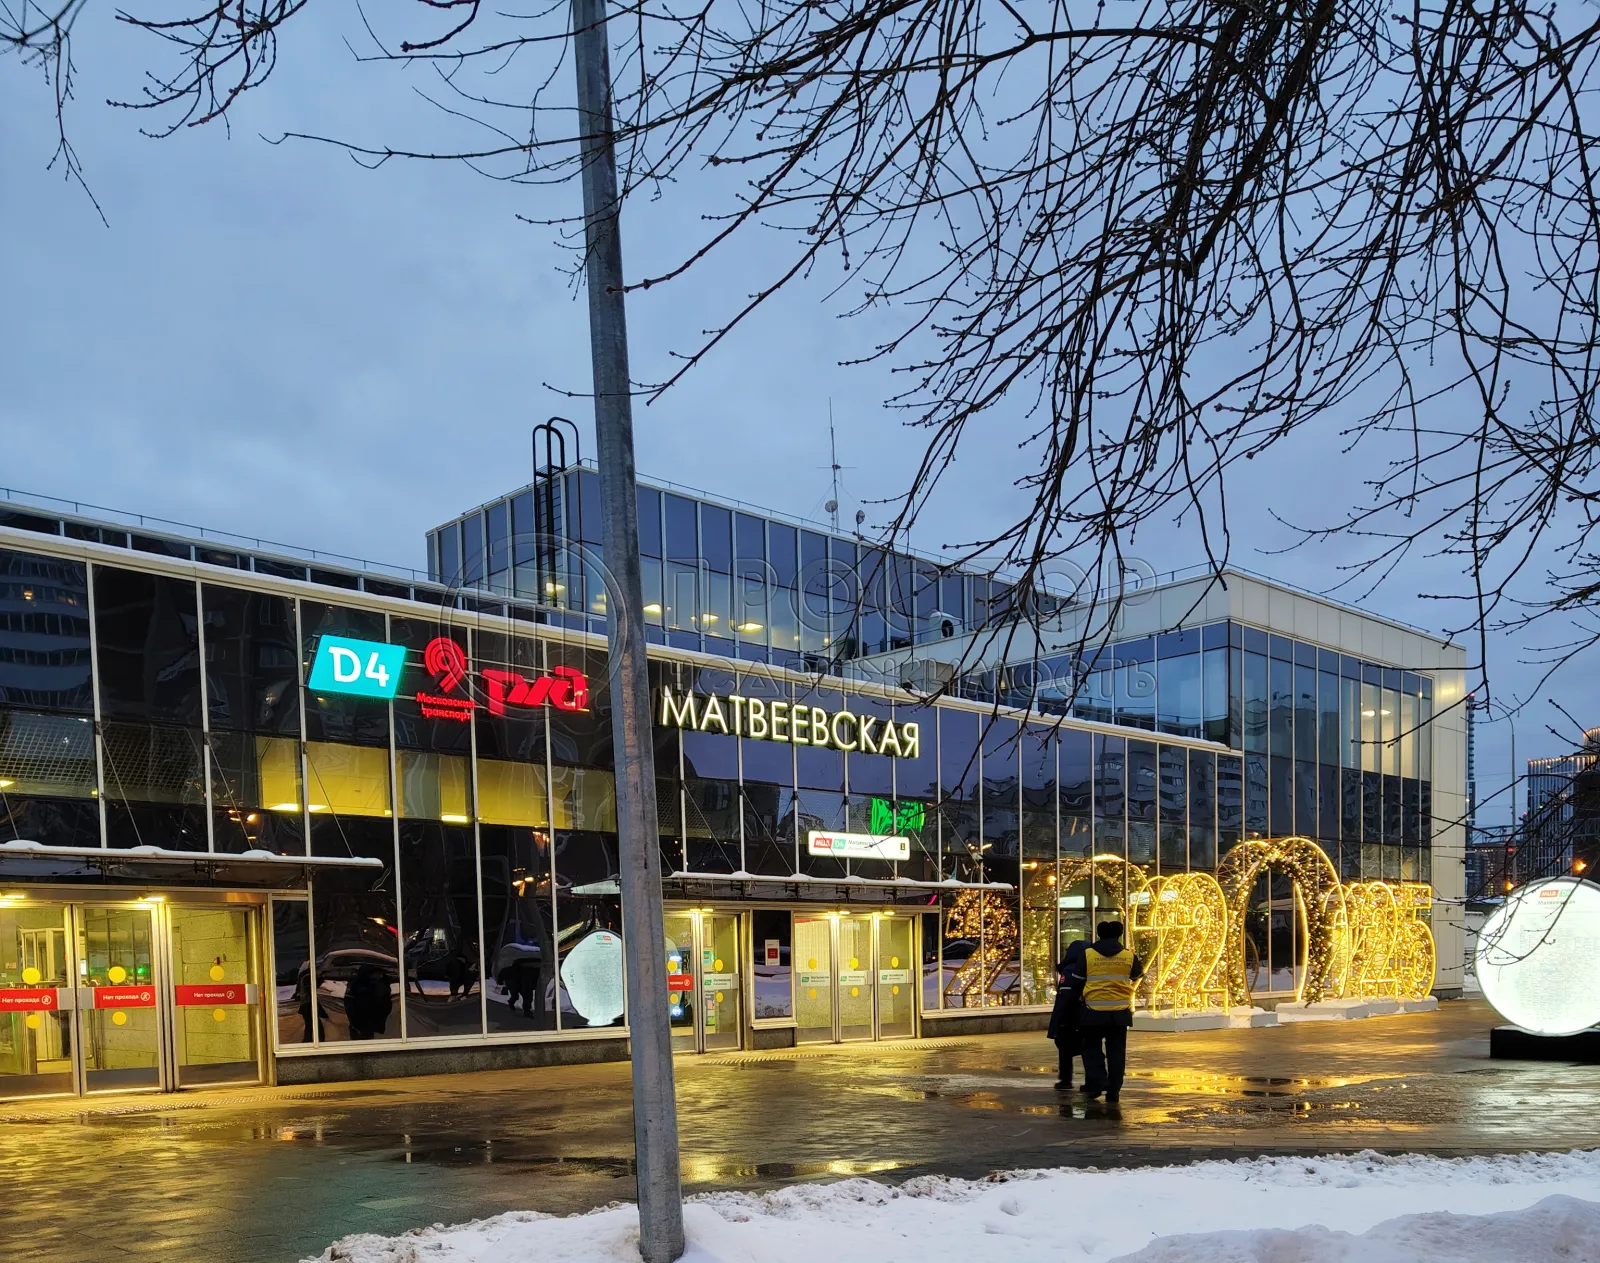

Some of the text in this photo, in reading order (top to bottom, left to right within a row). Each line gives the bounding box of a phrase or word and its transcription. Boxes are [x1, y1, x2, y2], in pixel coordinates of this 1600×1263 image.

[328, 646, 390, 687] D4
[416, 691, 476, 709] Московский
[422, 707, 471, 722] транспорт
[662, 685, 920, 759] МАТВЕЕВСКАЯ
